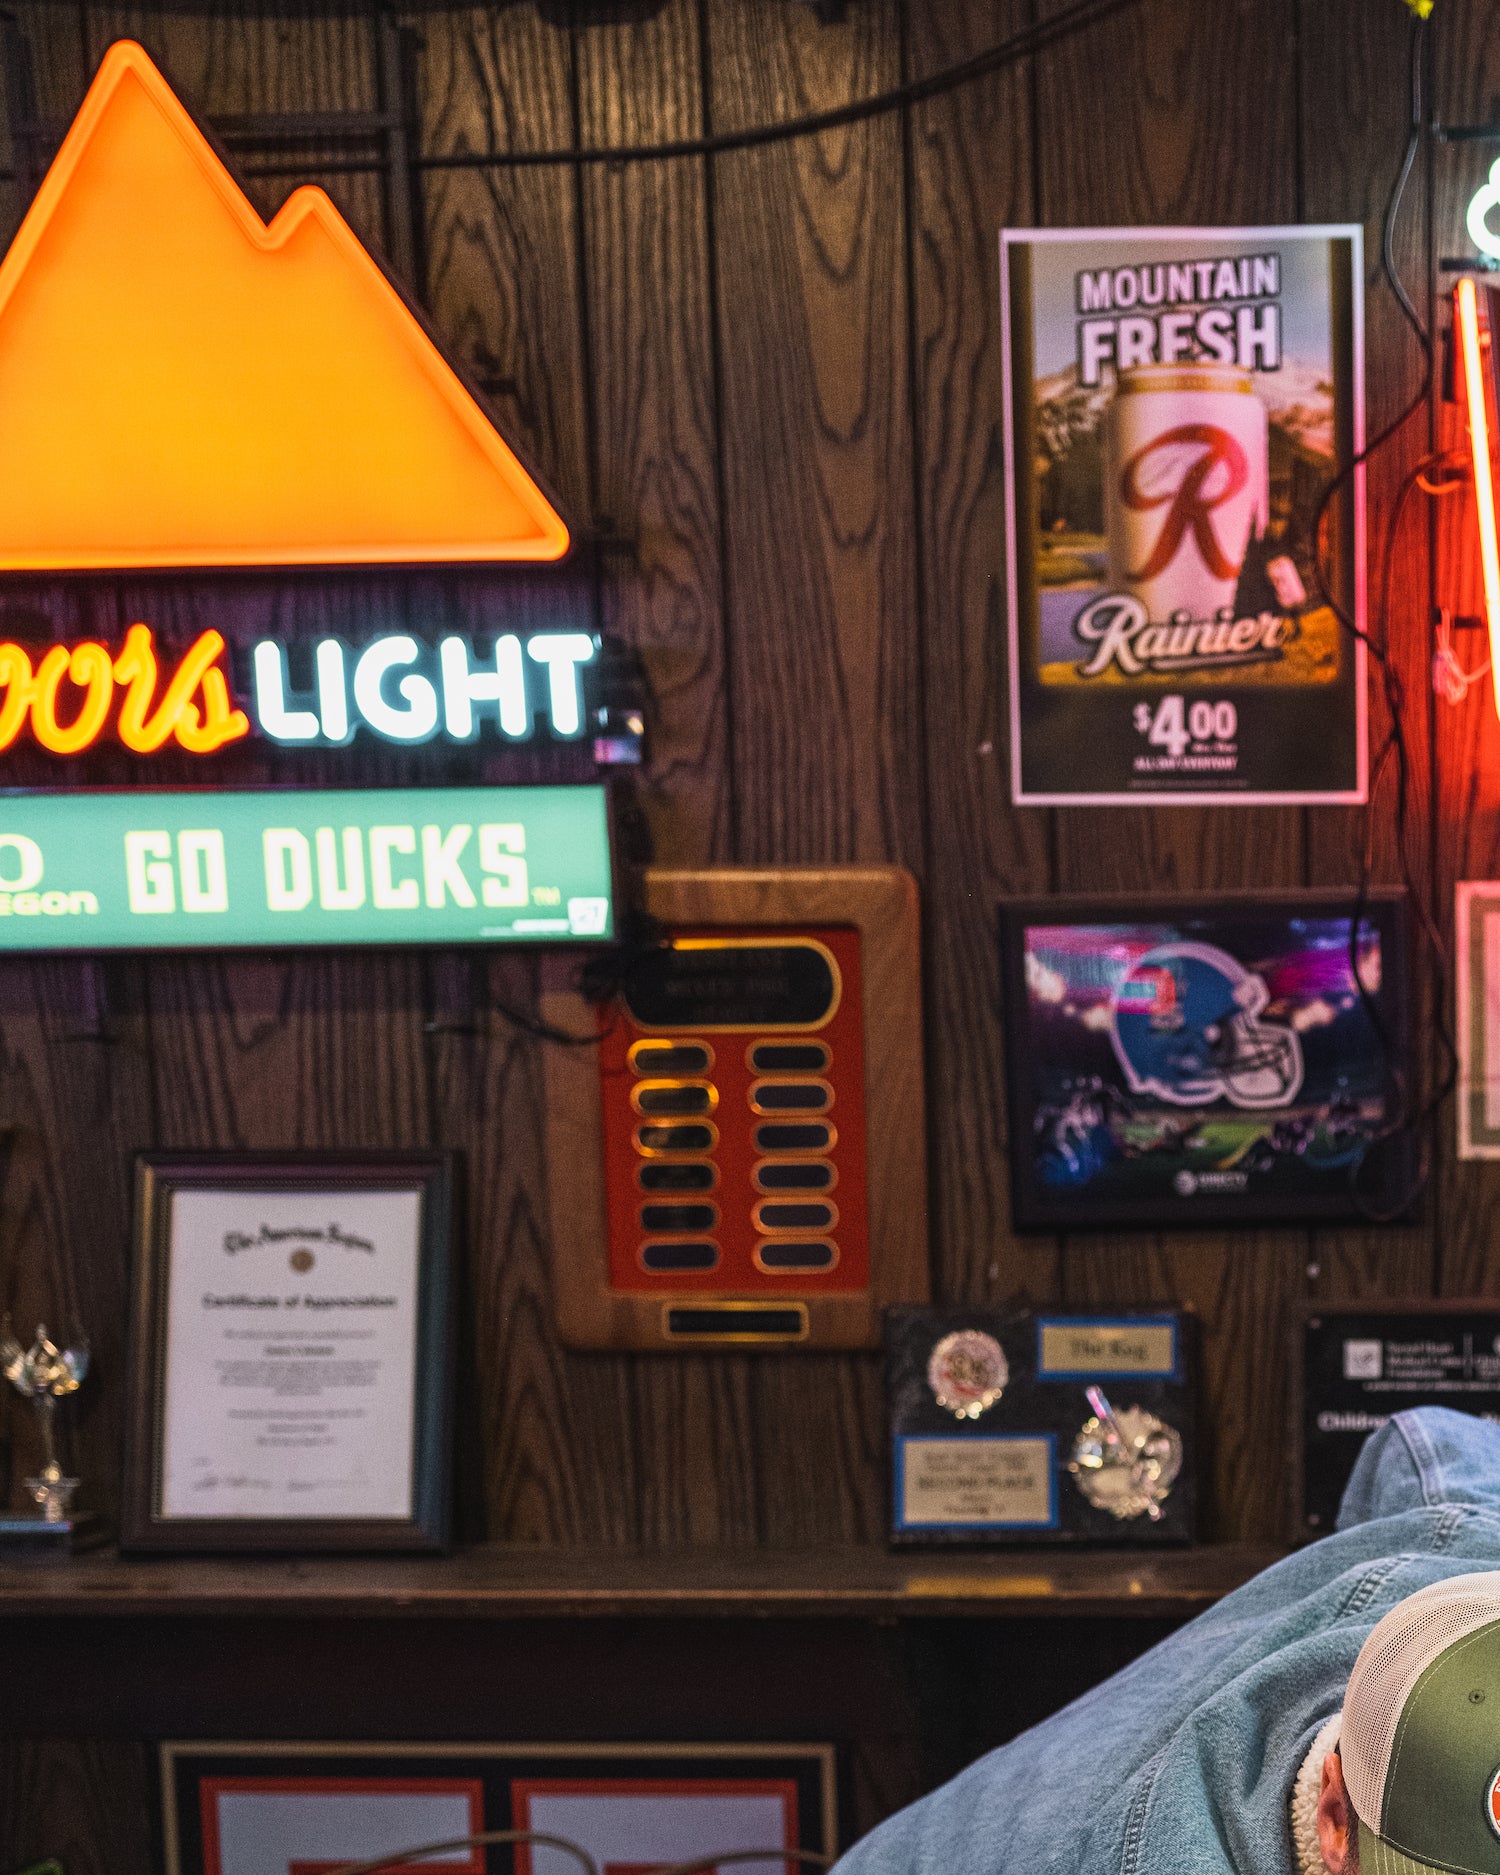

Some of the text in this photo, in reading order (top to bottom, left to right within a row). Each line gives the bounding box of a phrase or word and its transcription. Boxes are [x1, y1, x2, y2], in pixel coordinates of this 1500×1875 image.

[1079, 255, 1279, 312] MOUNTAIN
[1081, 306, 1280, 385] FRESH
[1077, 594, 1285, 676] Rainier
[0, 623, 596, 754] ors LIGHT
[124, 829, 229, 915] GO
[262, 822, 529, 911] DUCKS
